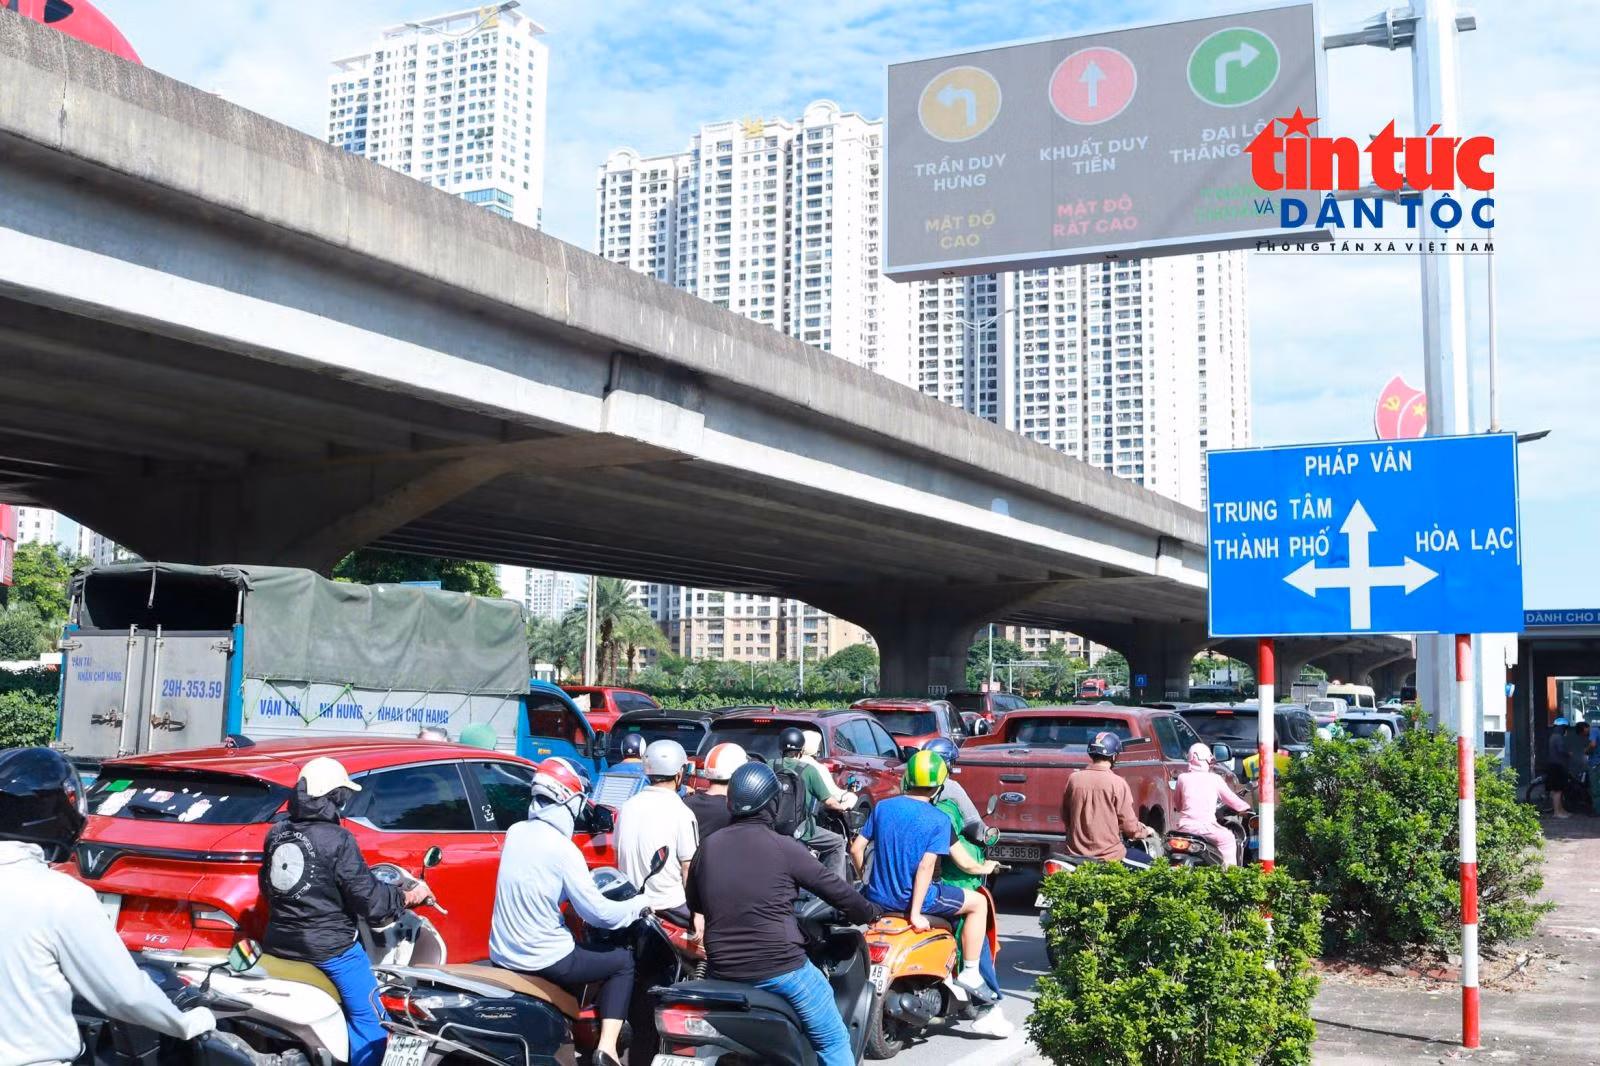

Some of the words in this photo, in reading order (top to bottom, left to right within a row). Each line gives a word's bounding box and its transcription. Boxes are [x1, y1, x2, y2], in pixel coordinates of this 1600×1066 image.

[1040, 137, 1103, 161] KHUẤT
[1108, 136, 1149, 154] DUY
[1170, 143, 1241, 164] THĂNG
[968, 153, 1007, 170] DUY
[934, 173, 987, 191] HƯNG
[1103, 193, 1133, 215] ĐỘ
[1095, 215, 1138, 235] CAO
[940, 233, 980, 249] CAO
[1305, 448, 1359, 477] PHÁP
[1370, 446, 1412, 472] VÂN
[1213, 500, 1278, 523] TRUNG
[1289, 493, 1333, 520] TÂM
[1214, 533, 1279, 560] THÀNH
[1289, 526, 1330, 558] PHỐ
[1416, 523, 1460, 552] HÒA
[1471, 527, 1514, 555] LẠC
[1566, 612, 1594, 622] CHO
[162, 679, 222, 699] 29H-353.59
[260, 696, 282, 719] VẬN
